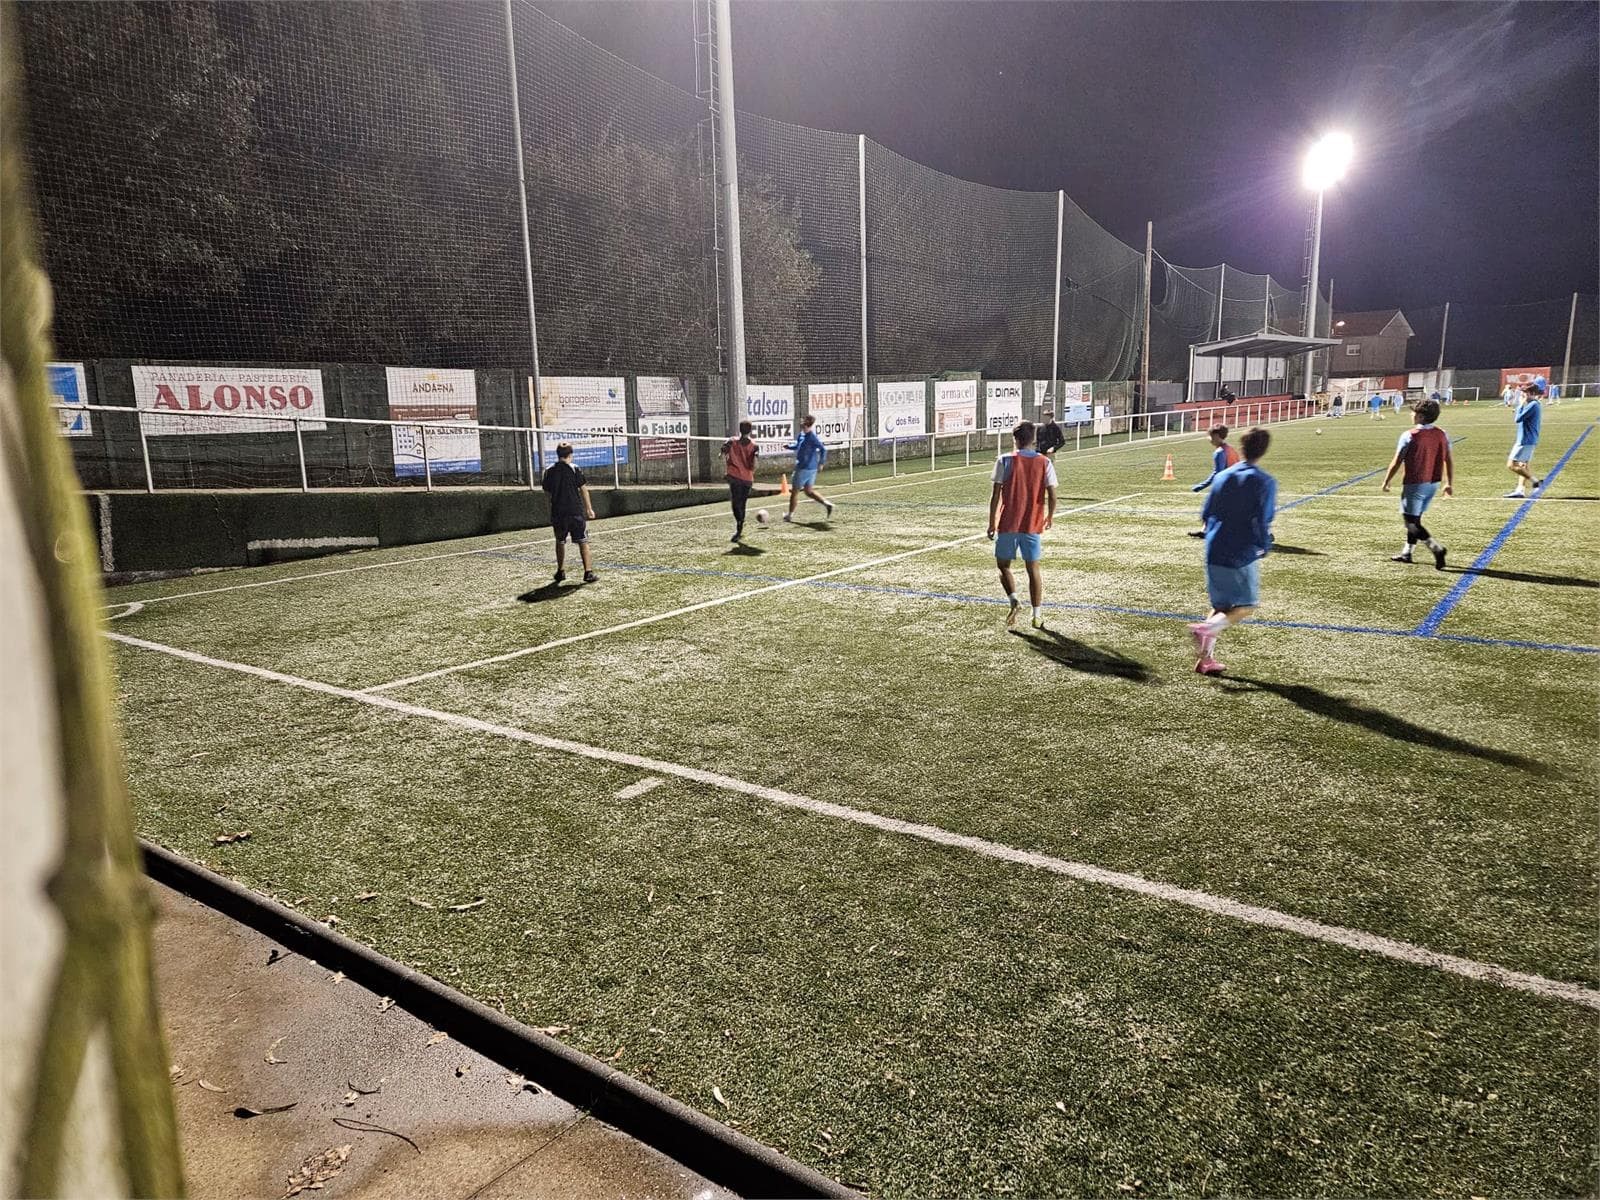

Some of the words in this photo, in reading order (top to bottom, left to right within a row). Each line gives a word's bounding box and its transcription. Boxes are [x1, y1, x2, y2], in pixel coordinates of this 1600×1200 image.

[153, 384, 314, 411] ALONSO
[941, 385, 975, 399] armacell
[995, 387, 1020, 397] DINAK
[747, 391, 788, 416] talsan
[895, 417, 907, 426] dos
[907, 416, 920, 425] Reis
[651, 422, 688, 435] Faiado
[750, 424, 791, 438] CHÜTZ
[766, 443, 784, 452] SYSTE
